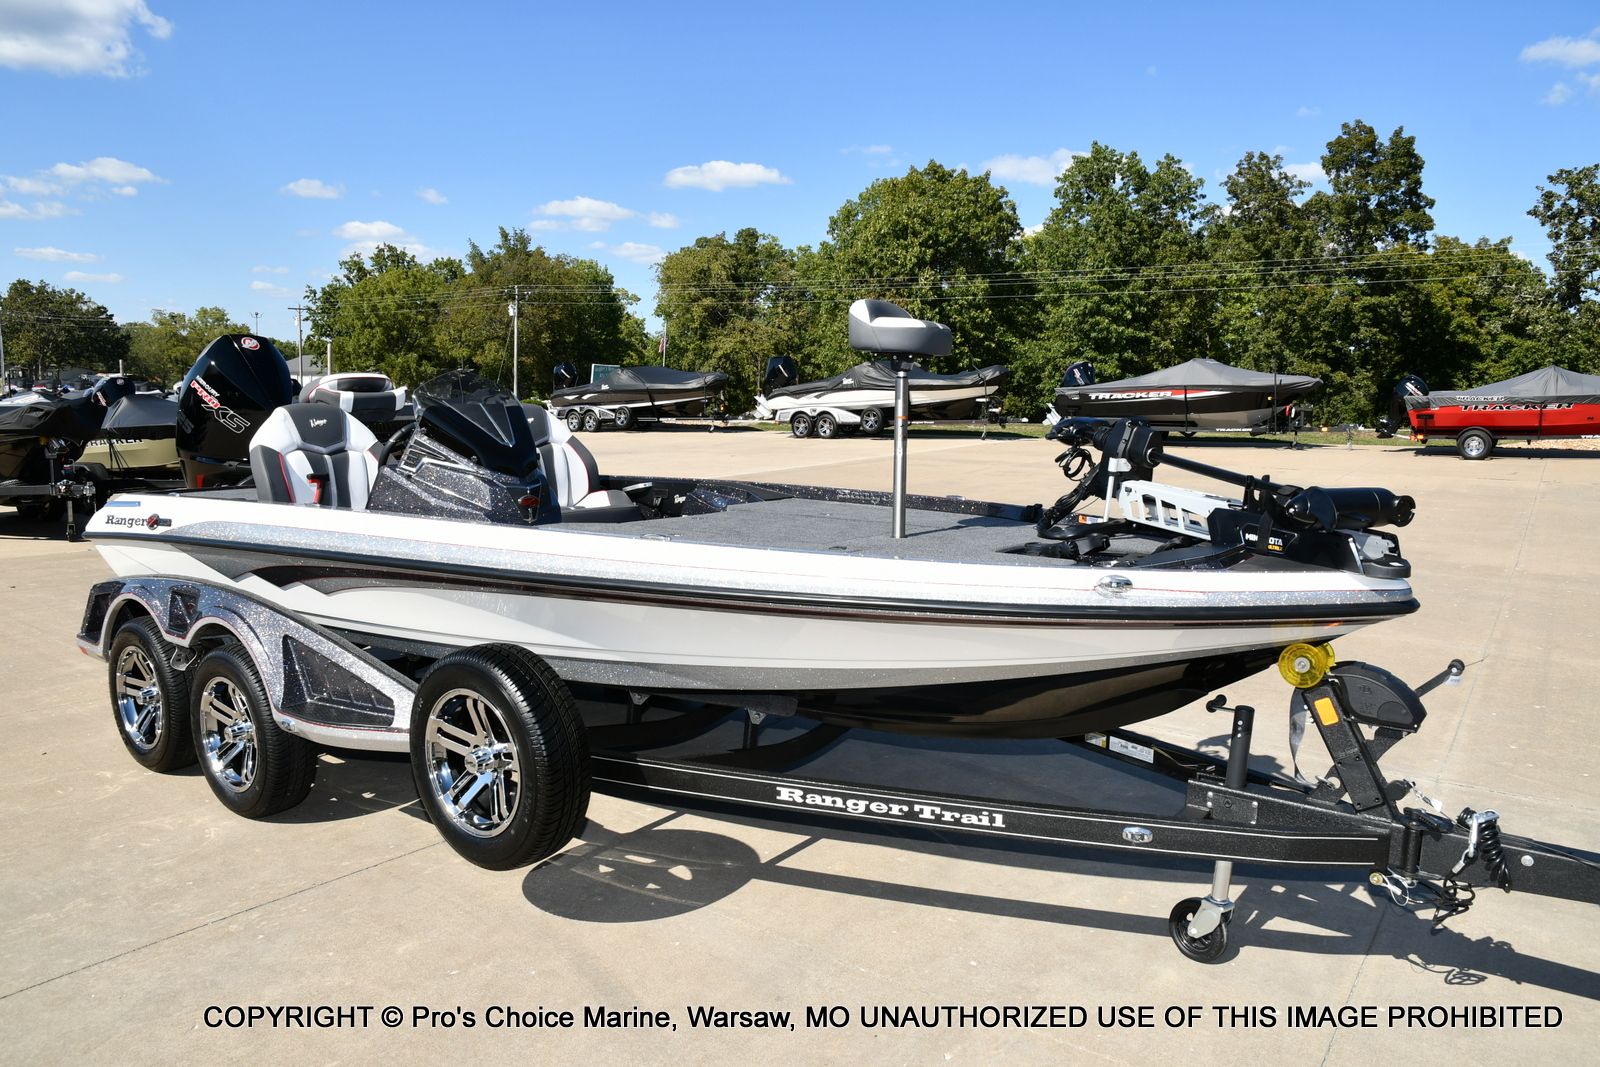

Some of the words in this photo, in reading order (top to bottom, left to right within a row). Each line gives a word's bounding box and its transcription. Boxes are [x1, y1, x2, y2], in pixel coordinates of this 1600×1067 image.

[1089, 391, 1173, 401] TRACKER
[1460, 402, 1574, 412] TRACKER
[104, 514, 149, 529] Ranger
[776, 786, 910, 815] Ranger
[913, 803, 1006, 828] Trail
